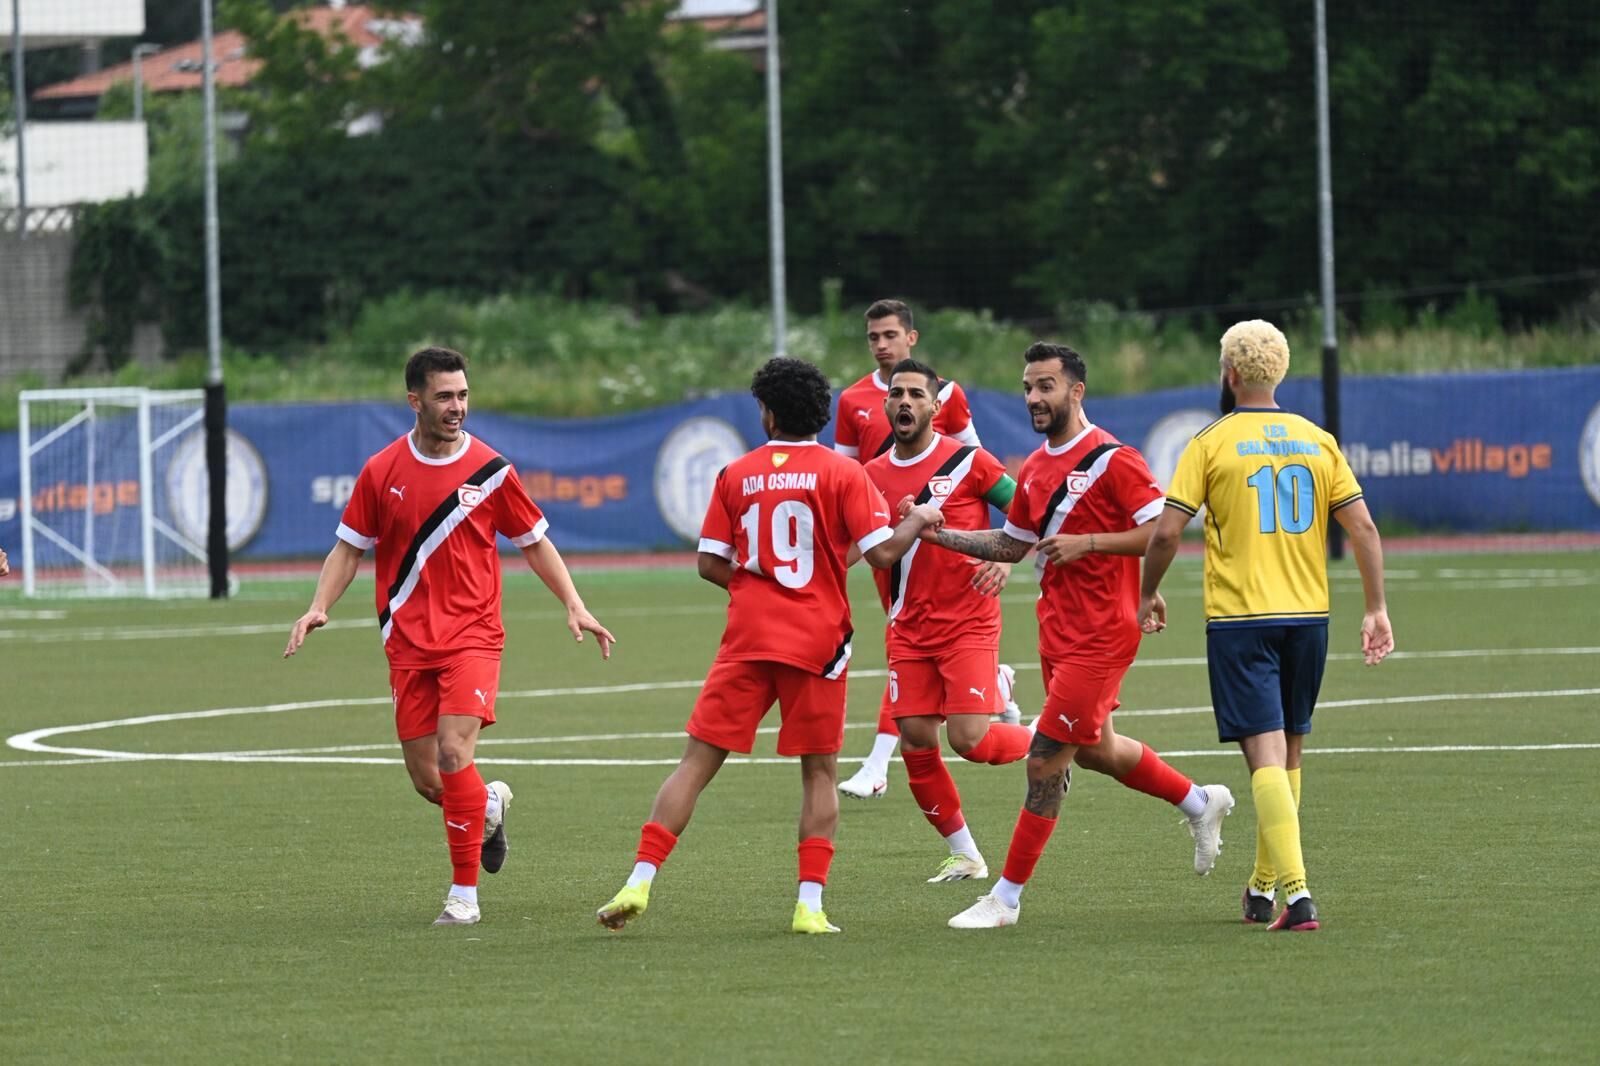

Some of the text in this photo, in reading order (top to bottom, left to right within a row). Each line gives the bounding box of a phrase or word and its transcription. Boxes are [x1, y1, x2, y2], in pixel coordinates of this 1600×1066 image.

[1263, 424, 1288, 438] LES
[742, 472, 818, 497] ADA OSMAN
[1247, 464, 1315, 535] 10
[741, 500, 815, 589] 19
